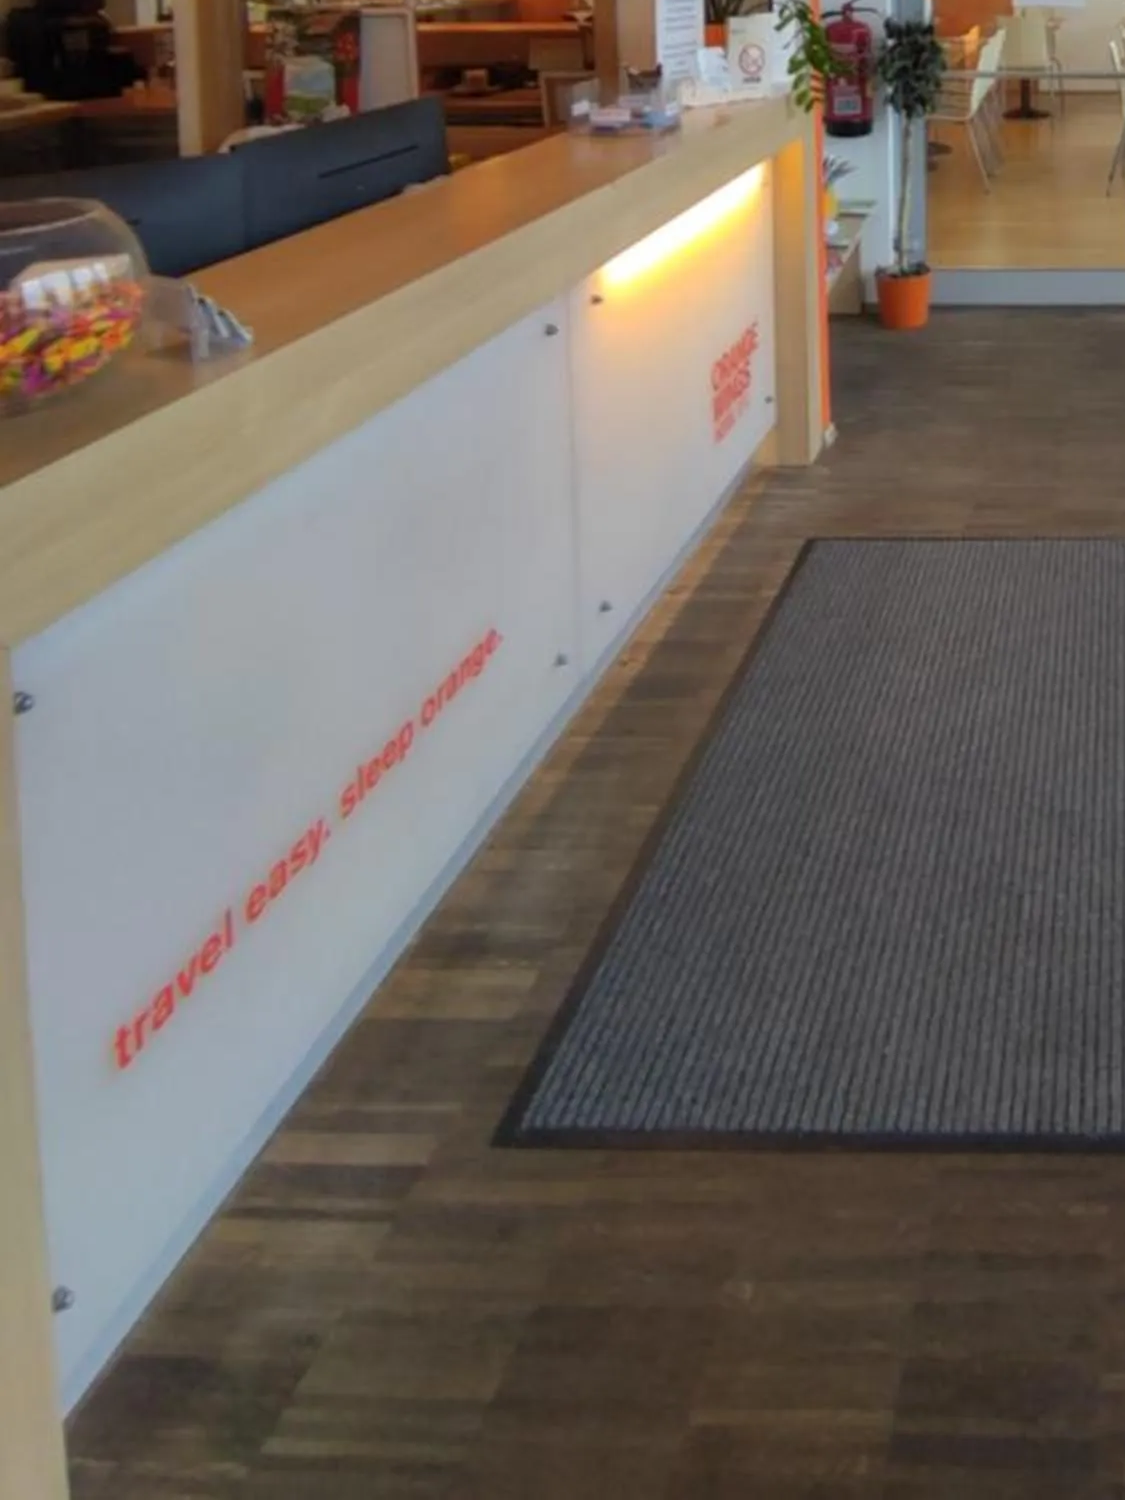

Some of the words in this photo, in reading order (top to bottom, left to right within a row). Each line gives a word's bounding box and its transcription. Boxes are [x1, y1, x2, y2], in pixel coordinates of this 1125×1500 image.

[113, 905, 233, 1069] travel
[246, 818, 331, 923] easy.
[339, 721, 414, 819] sleep
[419, 627, 503, 727] orange.
